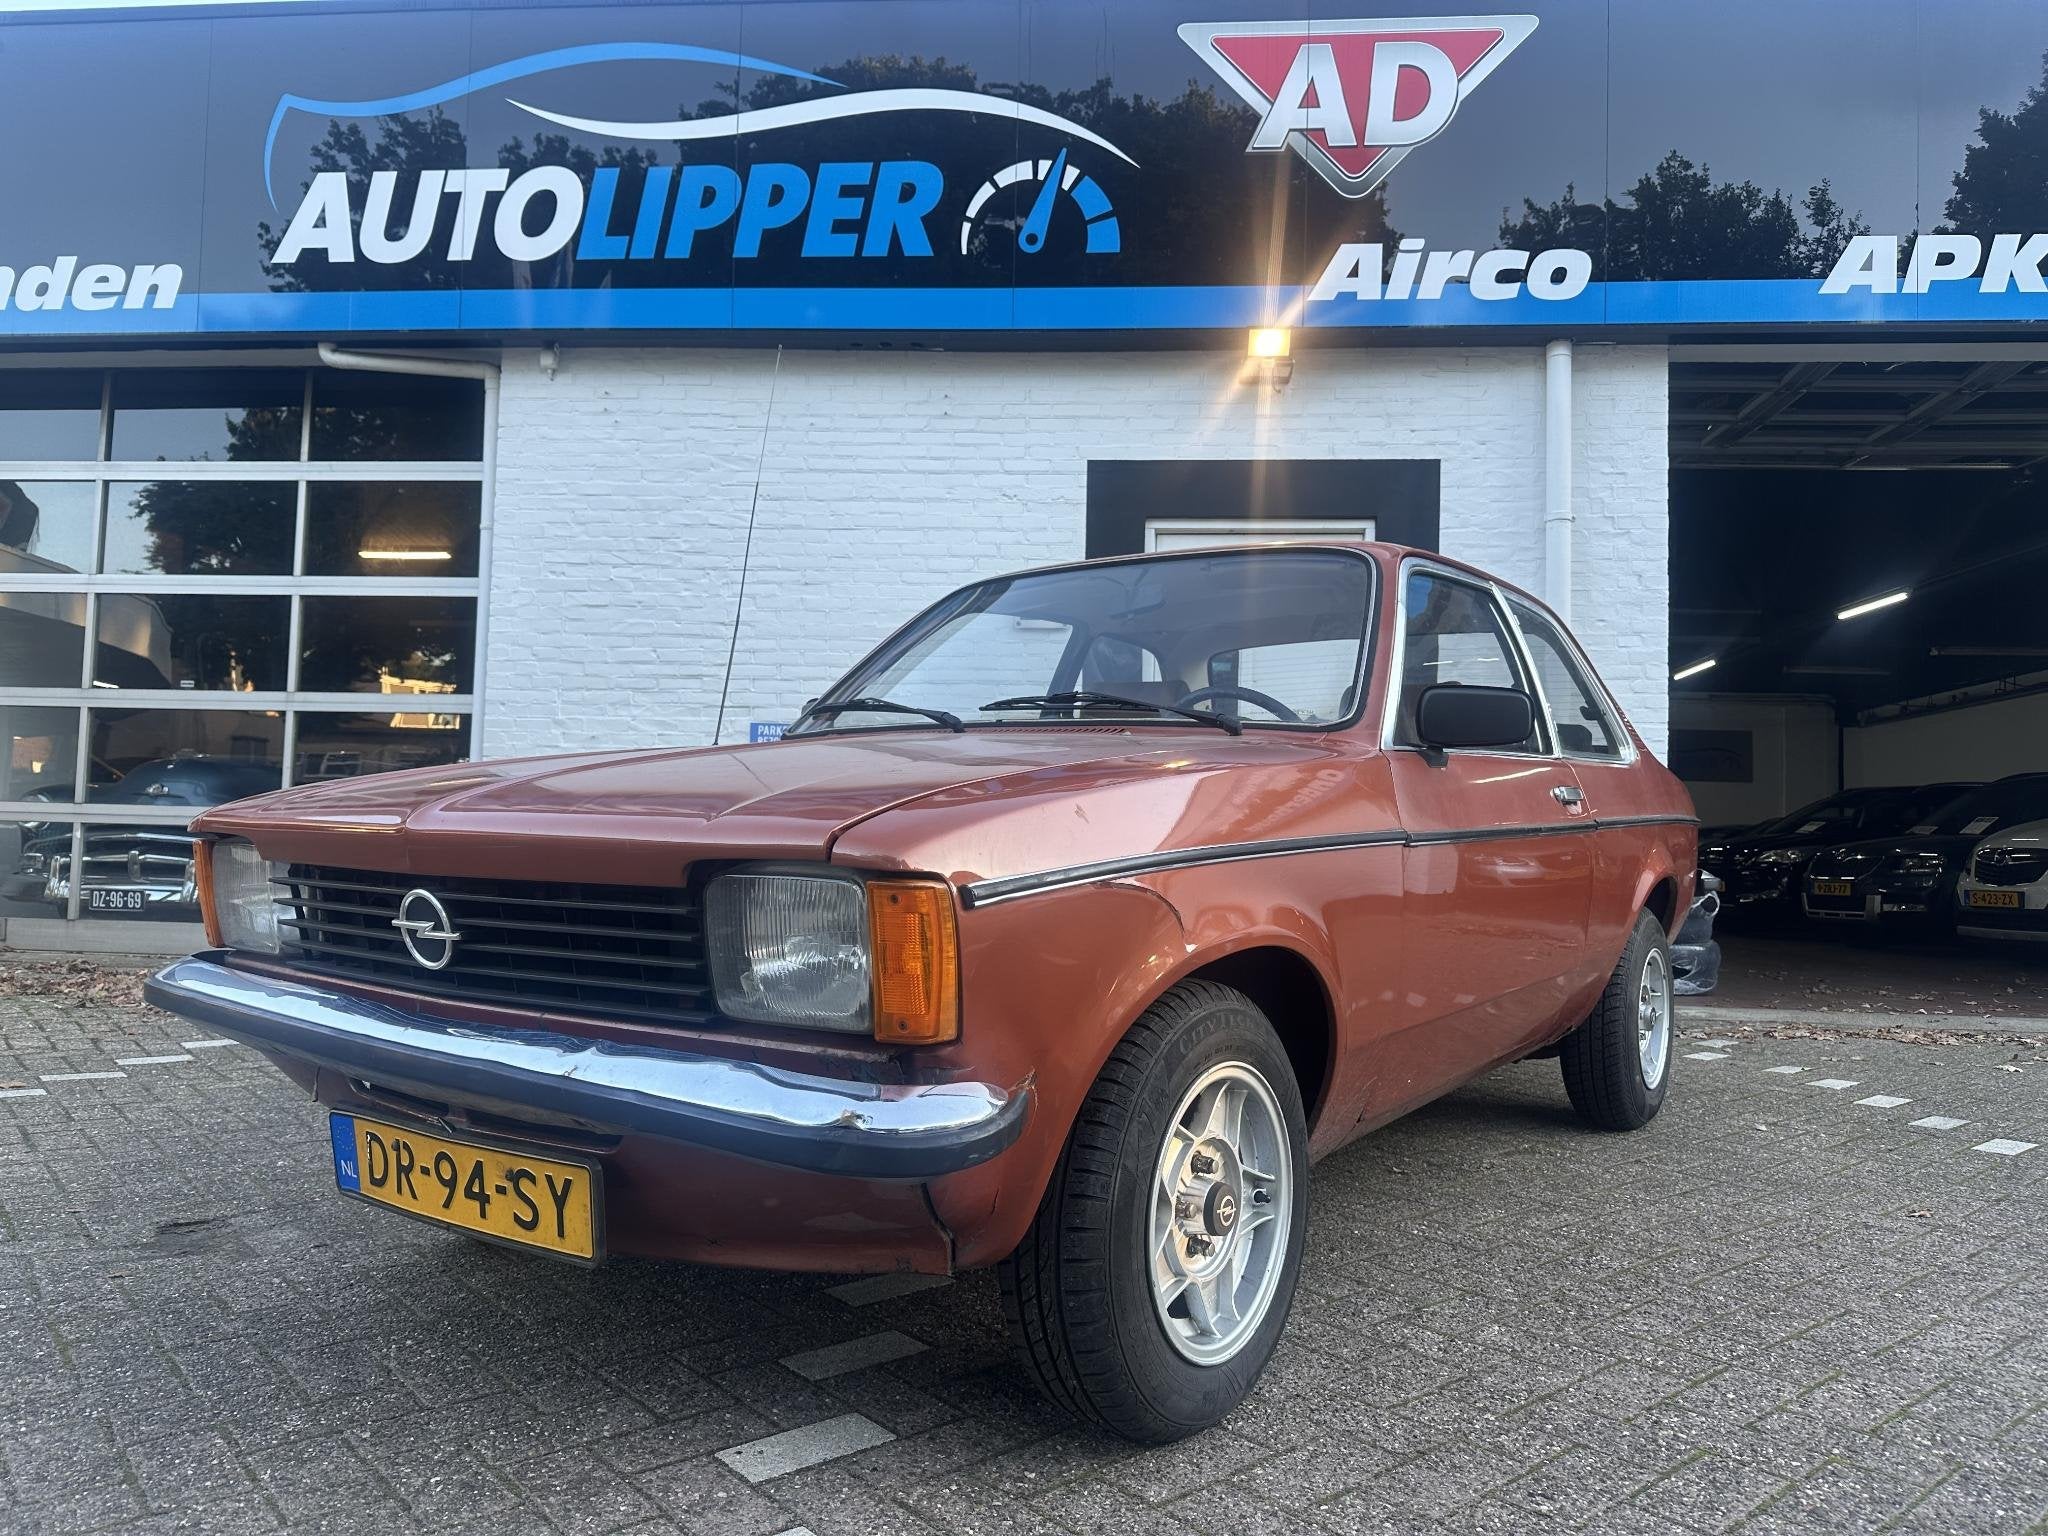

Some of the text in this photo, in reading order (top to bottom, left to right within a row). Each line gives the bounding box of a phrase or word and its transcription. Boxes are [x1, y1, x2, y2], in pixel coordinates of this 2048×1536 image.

[1253, 41, 1458, 147] AD
[0, 255, 183, 311] den
[1307, 239, 1592, 300] Airco
[1817, 233, 2048, 294] APK
[92, 891, 141, 908] DZ-96-69
[341, 1159, 357, 1177] NL
[365, 1130, 572, 1238] DR-94-SY
